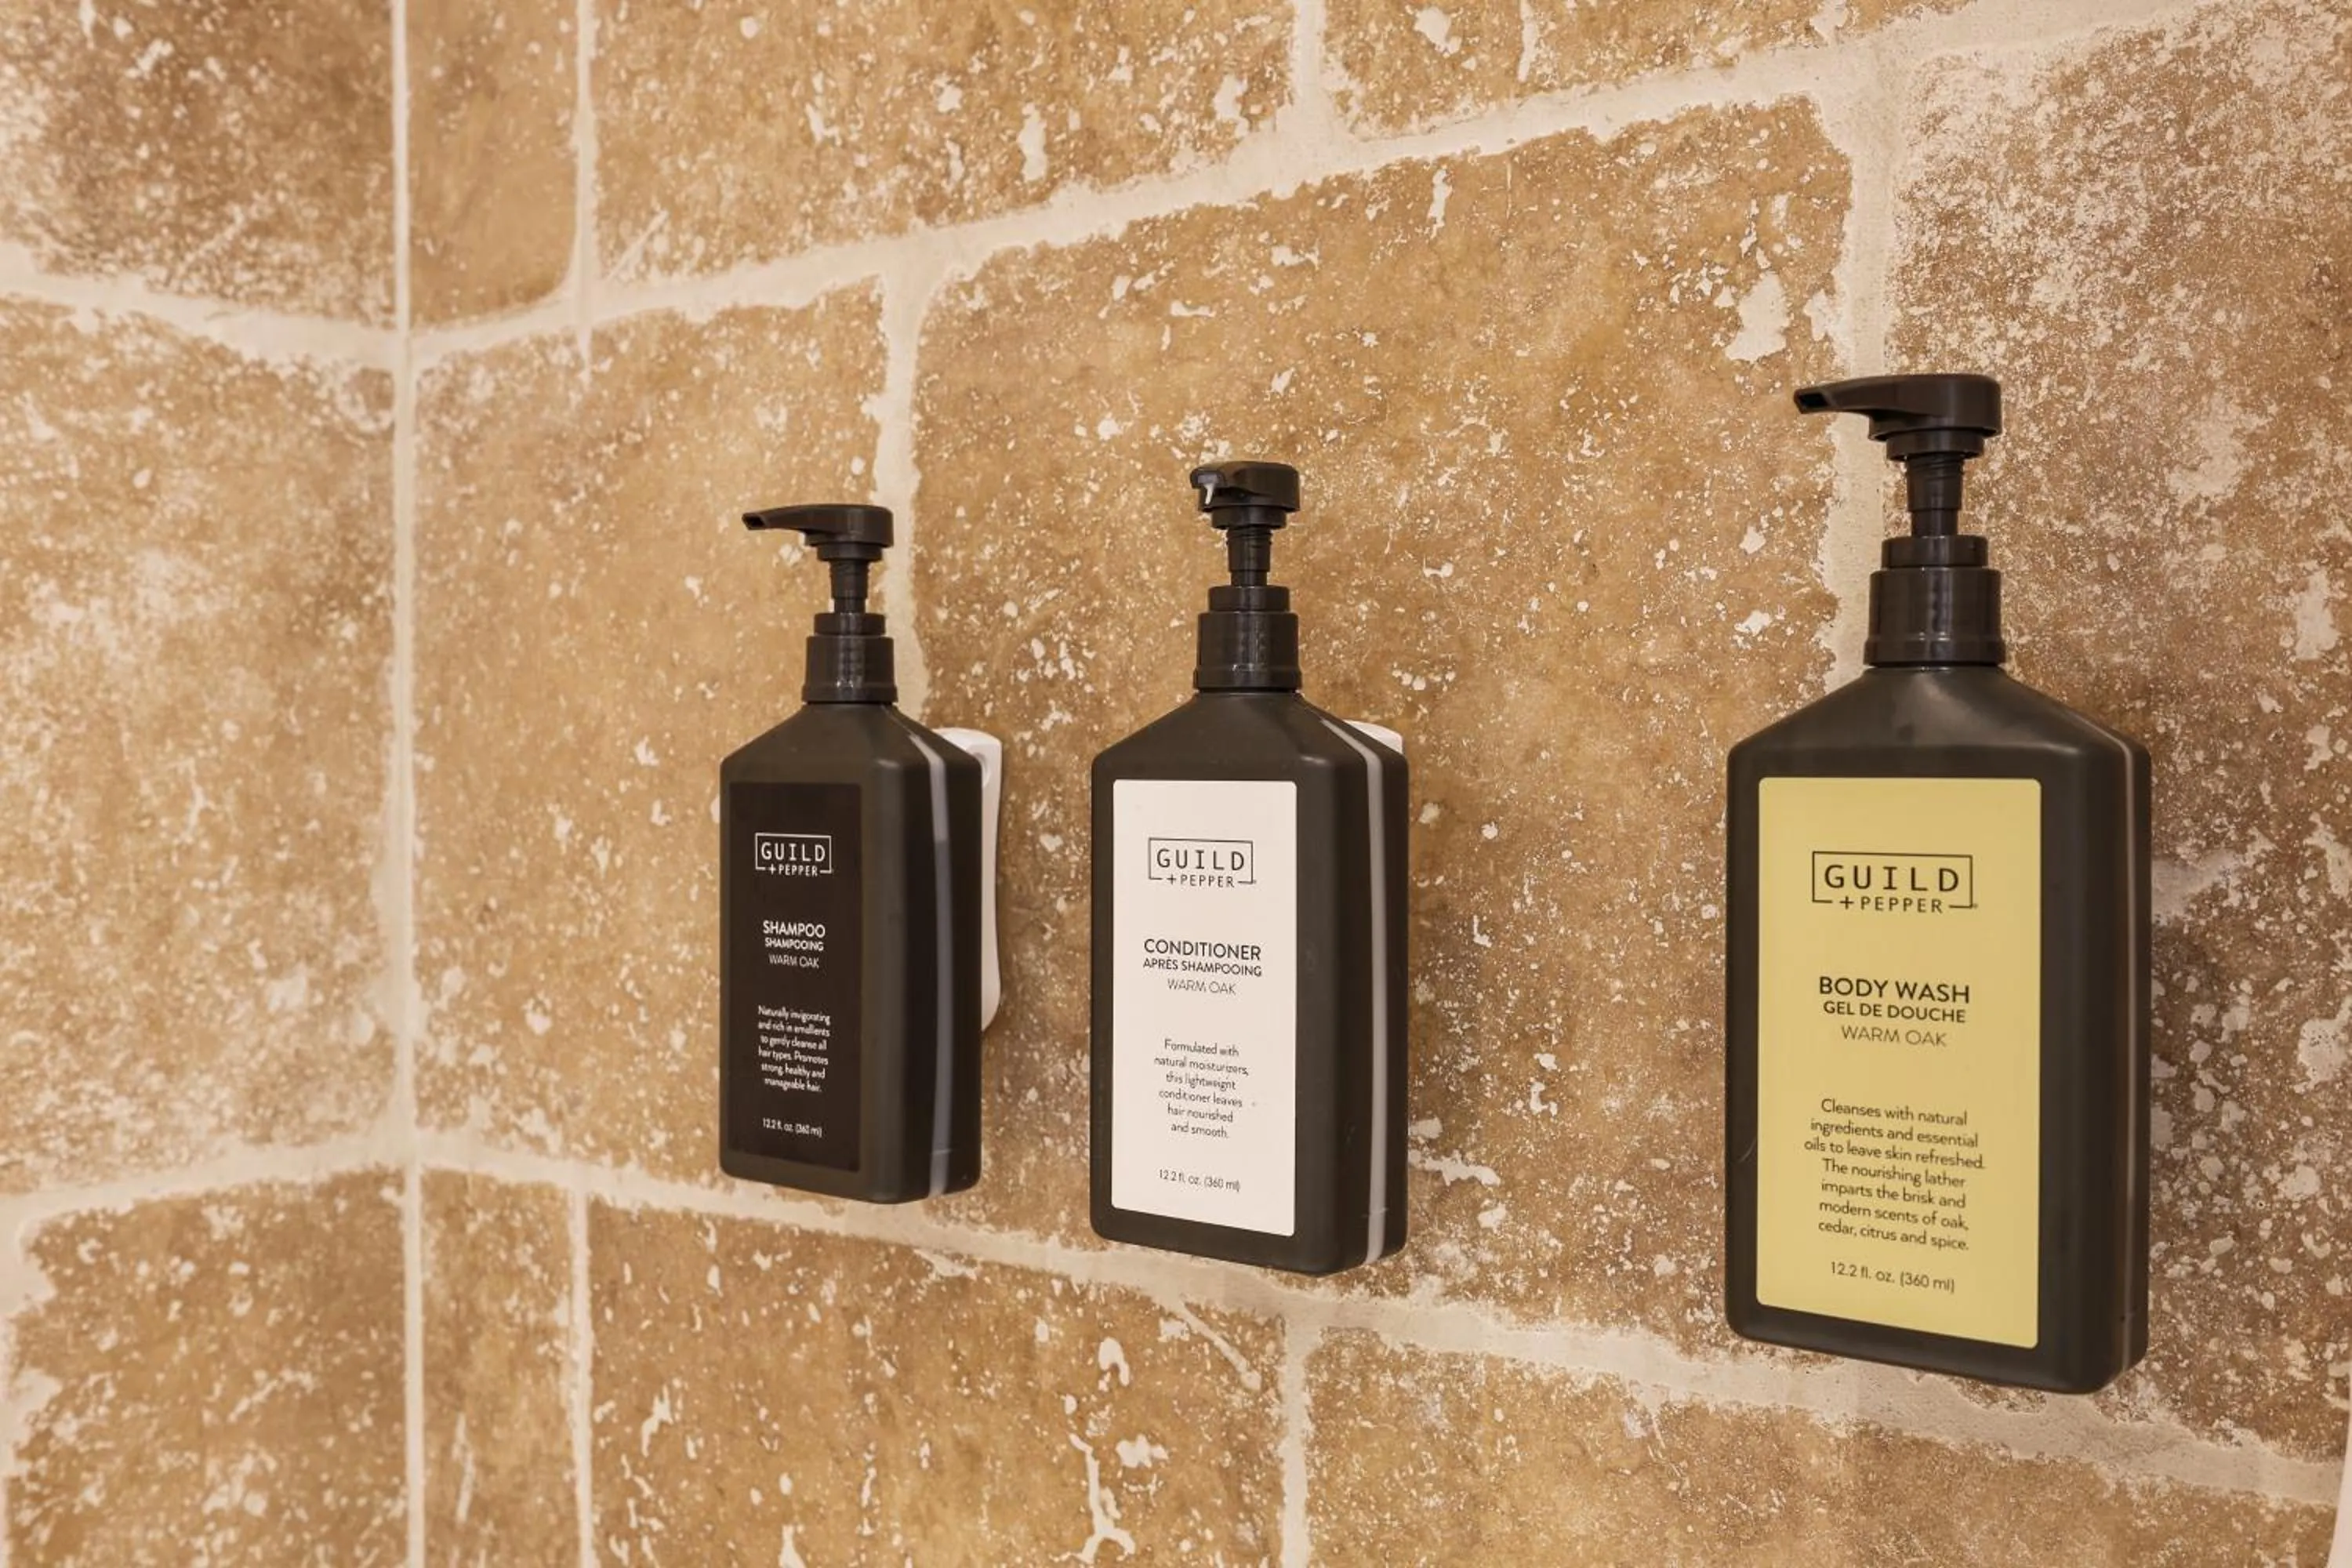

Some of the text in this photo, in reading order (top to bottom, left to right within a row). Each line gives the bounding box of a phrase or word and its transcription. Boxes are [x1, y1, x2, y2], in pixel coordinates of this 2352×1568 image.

[761, 842, 826, 862] GUILD
[1156, 848, 1244, 870] GUILD
[1824, 865, 1959, 892] GUILD
[763, 920, 826, 938] SHAMPOO
[765, 938, 824, 951] SHAMPOOING
[1144, 938, 1261, 961] CONDITIONER
[769, 953, 819, 968] WARM OAK
[1181, 961, 1262, 977] SHAMPOOING
[1167, 978, 1236, 995] WARM OAK
[1819, 976, 1969, 1004] BODY WASH
[758, 1005, 830, 1025] Naturally invigorating
[1824, 1000, 1965, 1023] GEL DE DOUCHE
[758, 1020, 771, 1029] and
[773, 1021, 784, 1031] rich
[786, 1022, 792, 1032] in
[1842, 1025, 1947, 1047] WARM OAK
[760, 1035, 768, 1044] to
[770, 1035, 790, 1047] gently
[792, 1036, 816, 1049] cleanse
[1164, 1039, 1239, 1057] Formulated with
[758, 1046, 771, 1056] hair
[794, 1051, 828, 1065] Promotes
[786, 1063, 809, 1078] healthy
[811, 1068, 825, 1079] and
[1154, 1057, 1249, 1076] natural moisturizers,
[1166, 1071, 1236, 1092] this lightweight
[1159, 1088, 1243, 1108] conditioner leaves
[1167, 1104, 1233, 1123] hair nourished
[1821, 1098, 1968, 1126] Cleanses with natural
[763, 1117, 775, 1129] 12.2
[1171, 1121, 1229, 1138] and smooth.
[1810, 1118, 1979, 1148] ingredients and essential
[1804, 1137, 1985, 1169] oils to leave skin refreshed.
[1821, 1158, 1965, 1188] The nourishing lather
[1203, 1177, 1224, 1189] (360
[1226, 1180, 1240, 1192] ml)
[1821, 1179, 1965, 1208] imparts the brisk and
[1819, 1200, 1969, 1230] modern scents of oak,
[1818, 1218, 1969, 1251] cedar, citrus and spice.
[1831, 1261, 1955, 1294] 12.2 fl. oz. (360 ml)
